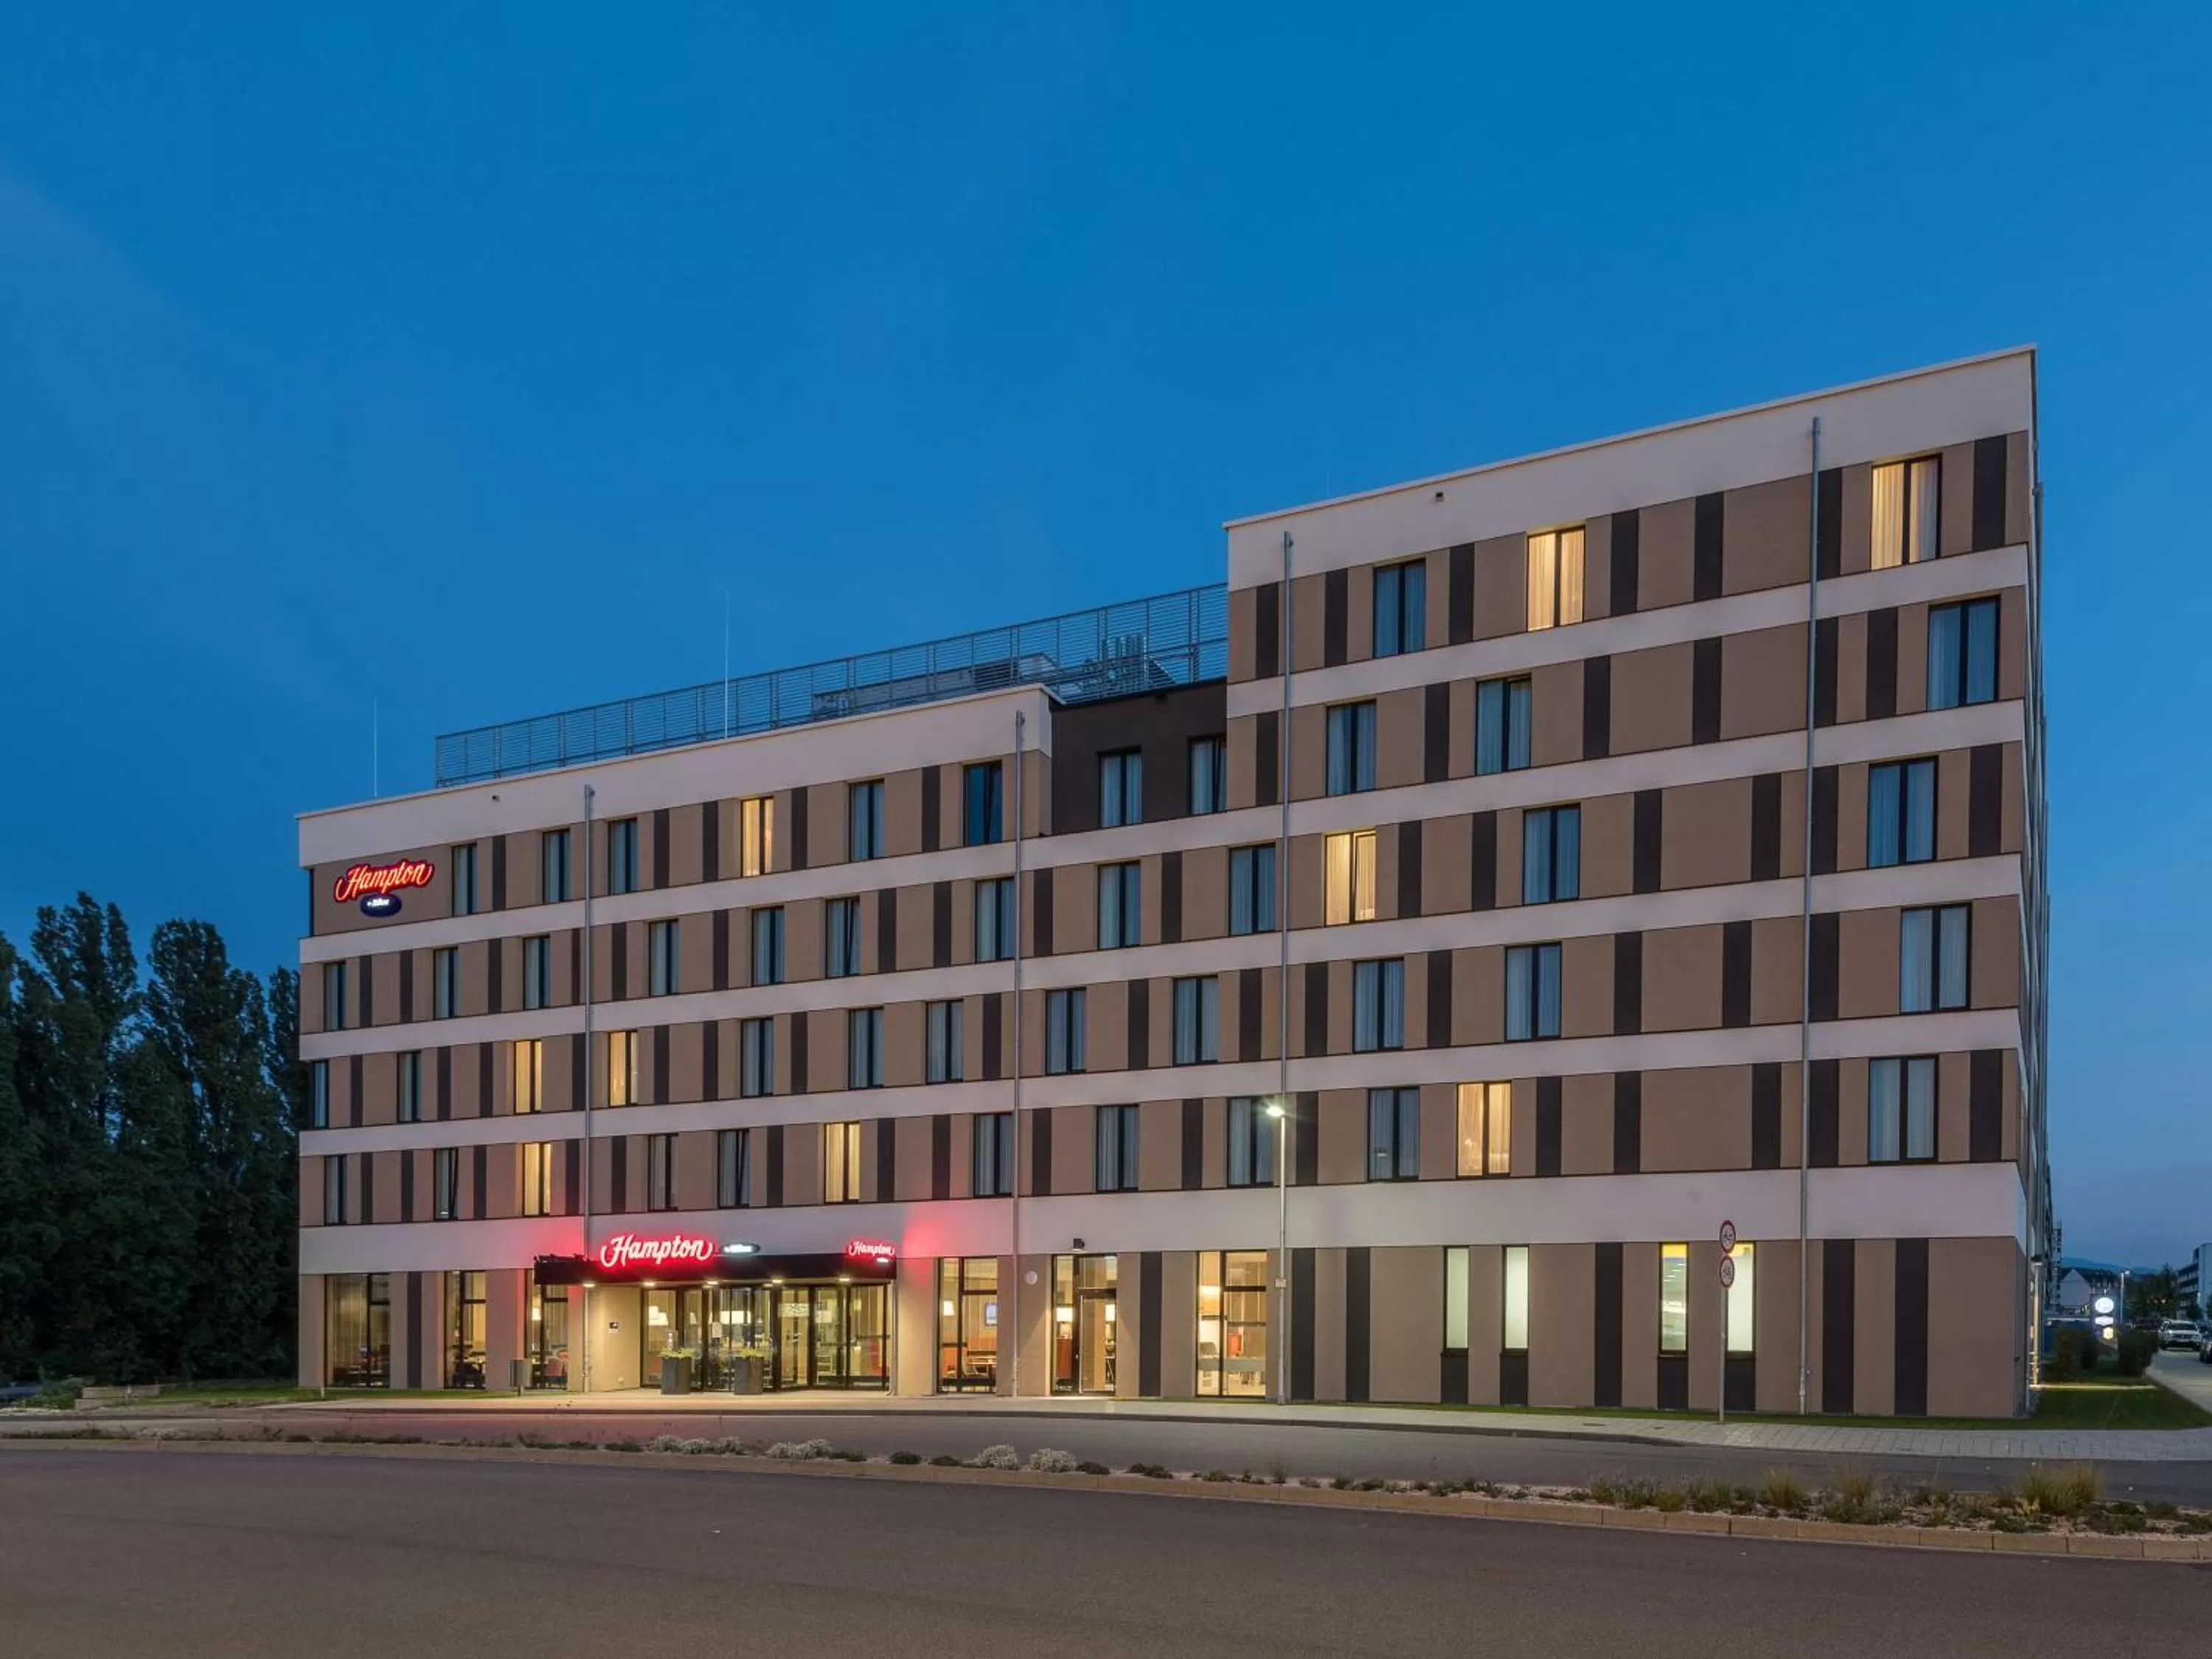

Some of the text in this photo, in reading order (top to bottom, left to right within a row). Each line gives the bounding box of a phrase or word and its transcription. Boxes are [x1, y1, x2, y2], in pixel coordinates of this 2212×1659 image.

[335, 860, 434, 901] Hampton
[600, 1234, 712, 1267] Hampton
[848, 1241, 896, 1257] Hampton
